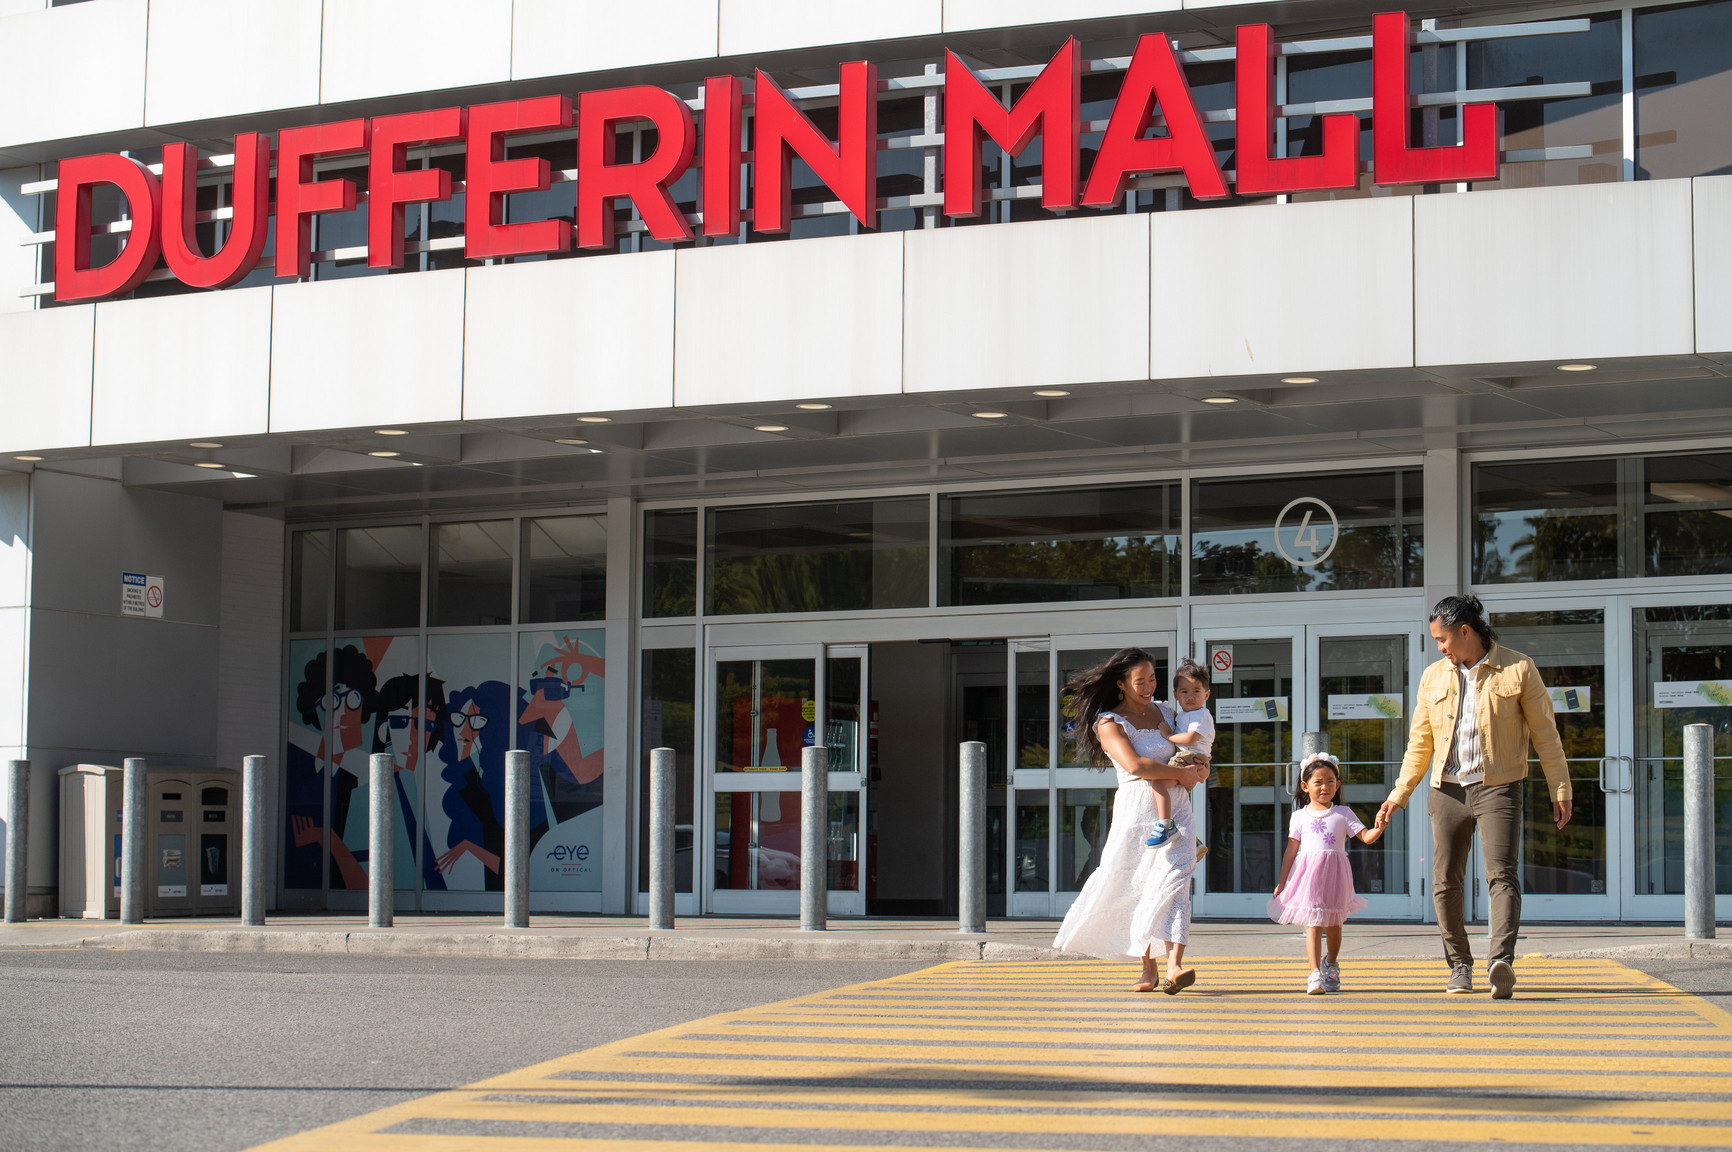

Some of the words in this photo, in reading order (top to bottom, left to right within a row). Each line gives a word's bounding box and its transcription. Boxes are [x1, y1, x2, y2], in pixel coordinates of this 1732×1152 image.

[54, 60, 878, 303] DUFFERIN
[943, 11, 1500, 218] MALL
[1294, 510, 1319, 553] 4
[124, 575, 144, 584] NOTICE
